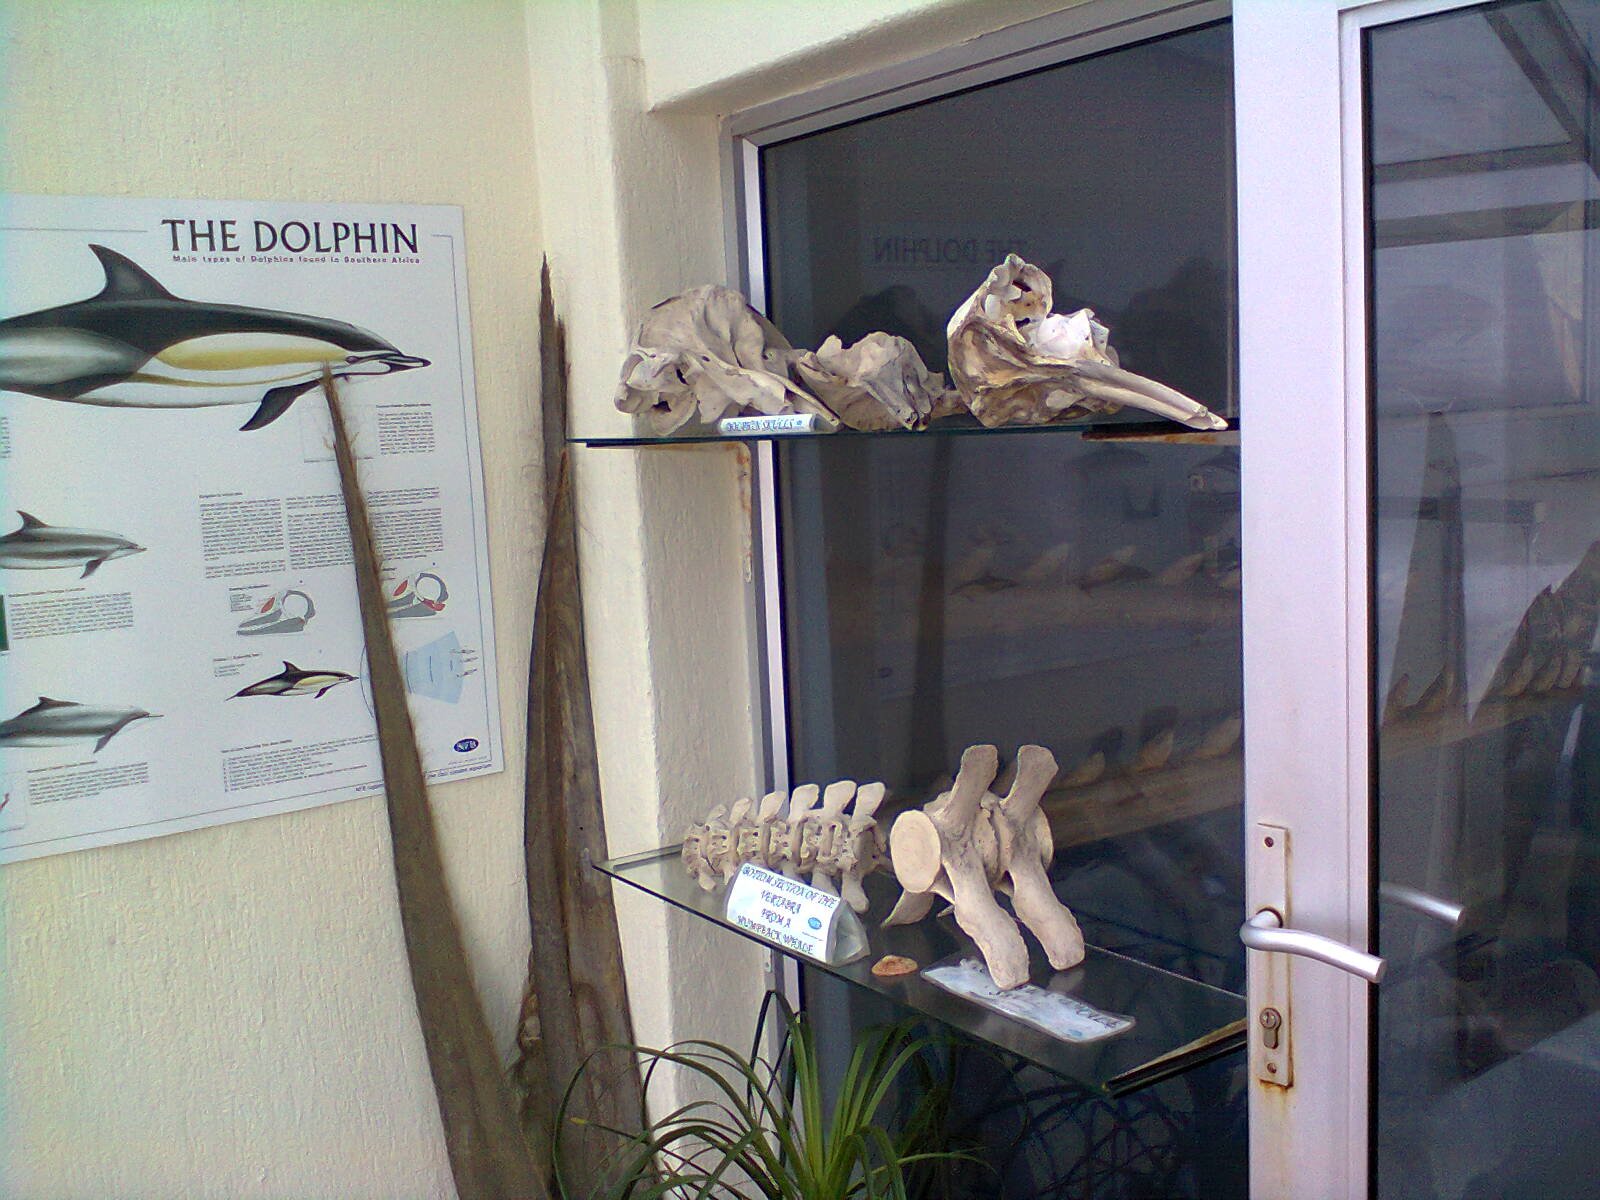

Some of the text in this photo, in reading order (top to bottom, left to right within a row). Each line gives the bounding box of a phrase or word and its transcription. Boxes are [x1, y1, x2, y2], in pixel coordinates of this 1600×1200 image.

[161, 219, 419, 254] THE DOLPHIN
[172, 254, 420, 265] Main types of Dolphins found in Southern Africa
[770, 876, 806, 897] SECTION
[805, 889, 819, 902] OF
[817, 894, 838, 909] THE
